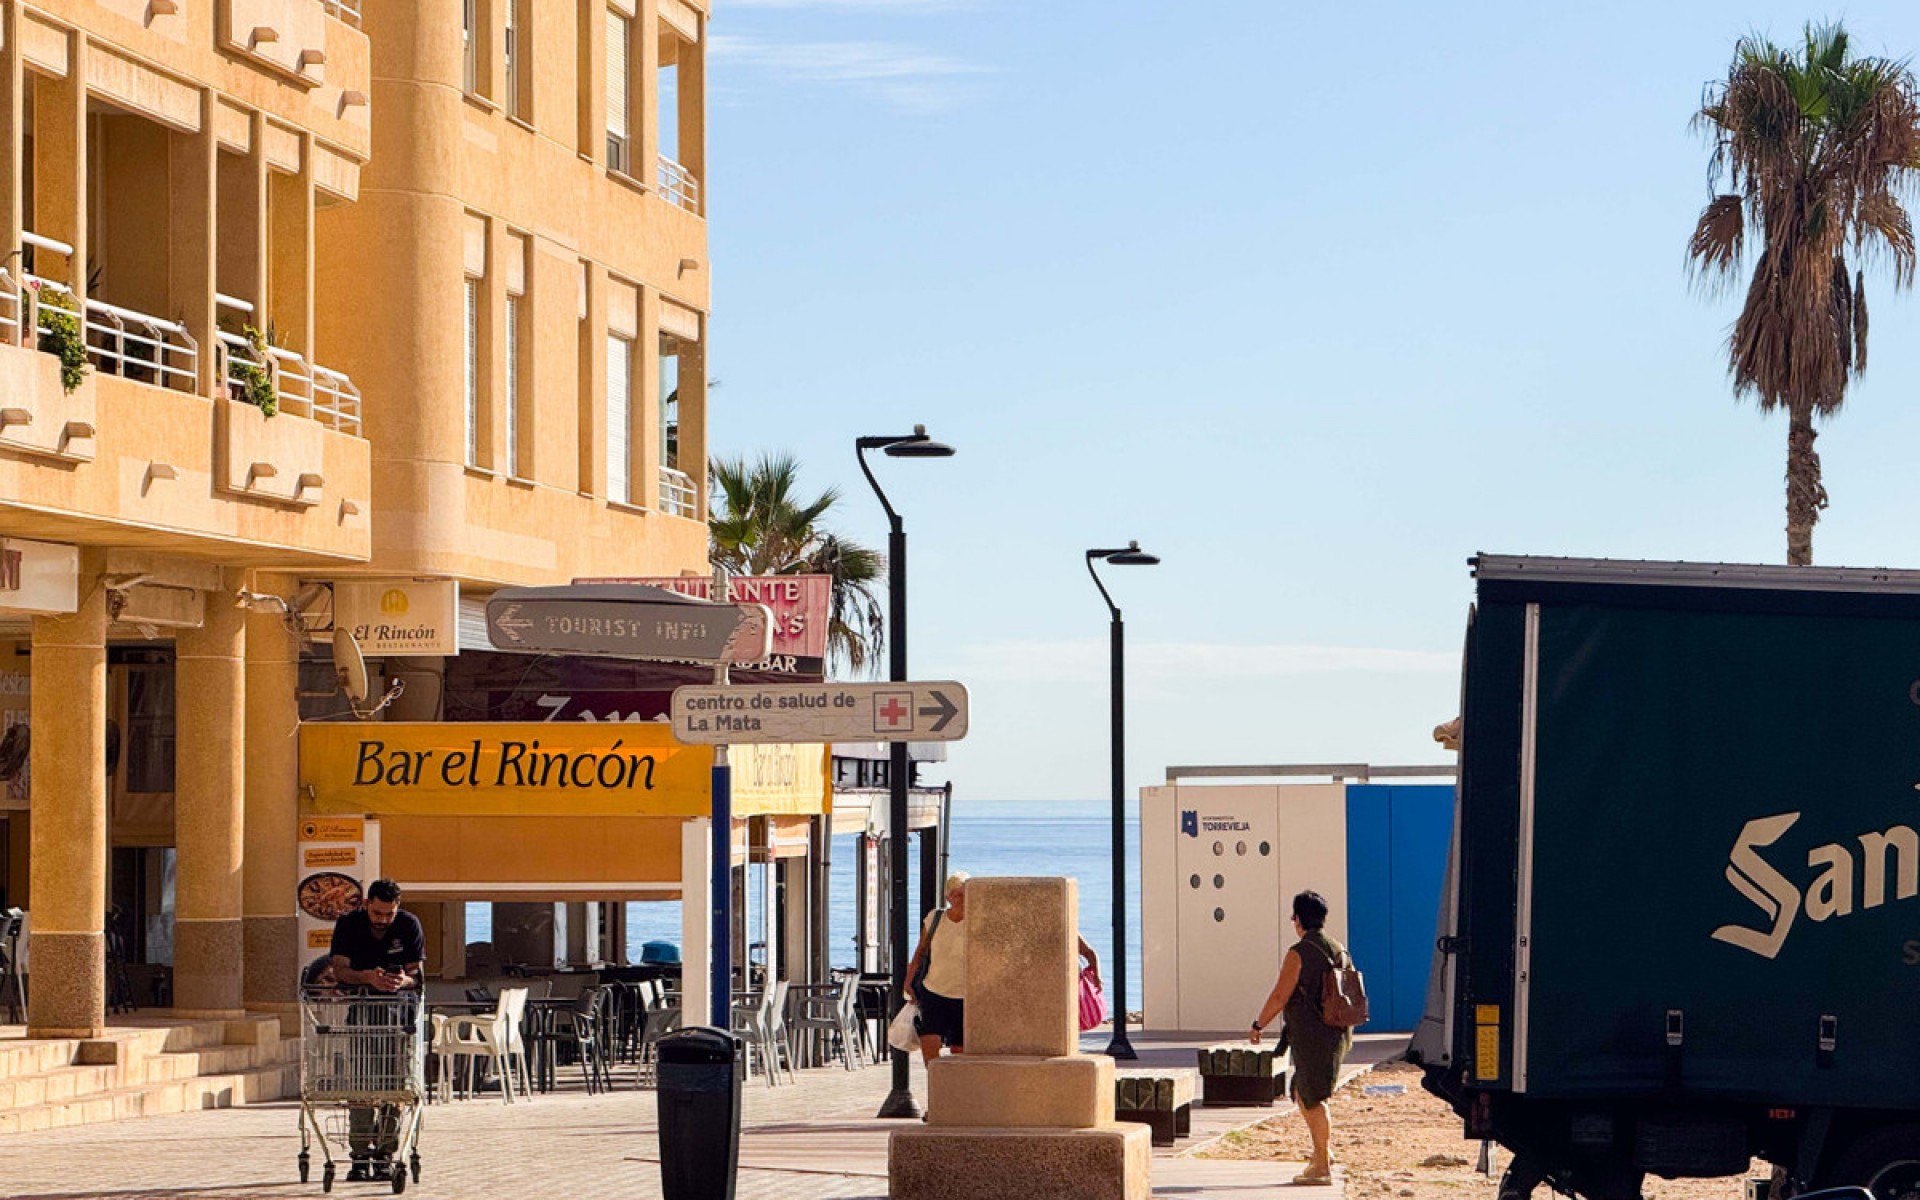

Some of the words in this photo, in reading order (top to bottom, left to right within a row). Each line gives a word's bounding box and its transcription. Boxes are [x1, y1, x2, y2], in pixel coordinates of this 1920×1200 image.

[353, 623, 370, 641] El
[374, 623, 436, 641] Rincón
[546, 617, 641, 638] TOURIST
[759, 654, 798, 673] BAR
[686, 694, 744, 711] centro
[750, 693, 772, 709] de
[778, 693, 827, 708] salud
[833, 692, 856, 708] de
[687, 716, 708, 731] La
[716, 715, 761, 731] Mata
[352, 740, 433, 787] Bar
[441, 739, 482, 787] el
[494, 738, 656, 790] Rincón
[1202, 821, 1251, 832] TORREVIEJA
[1710, 811, 1920, 960] San
